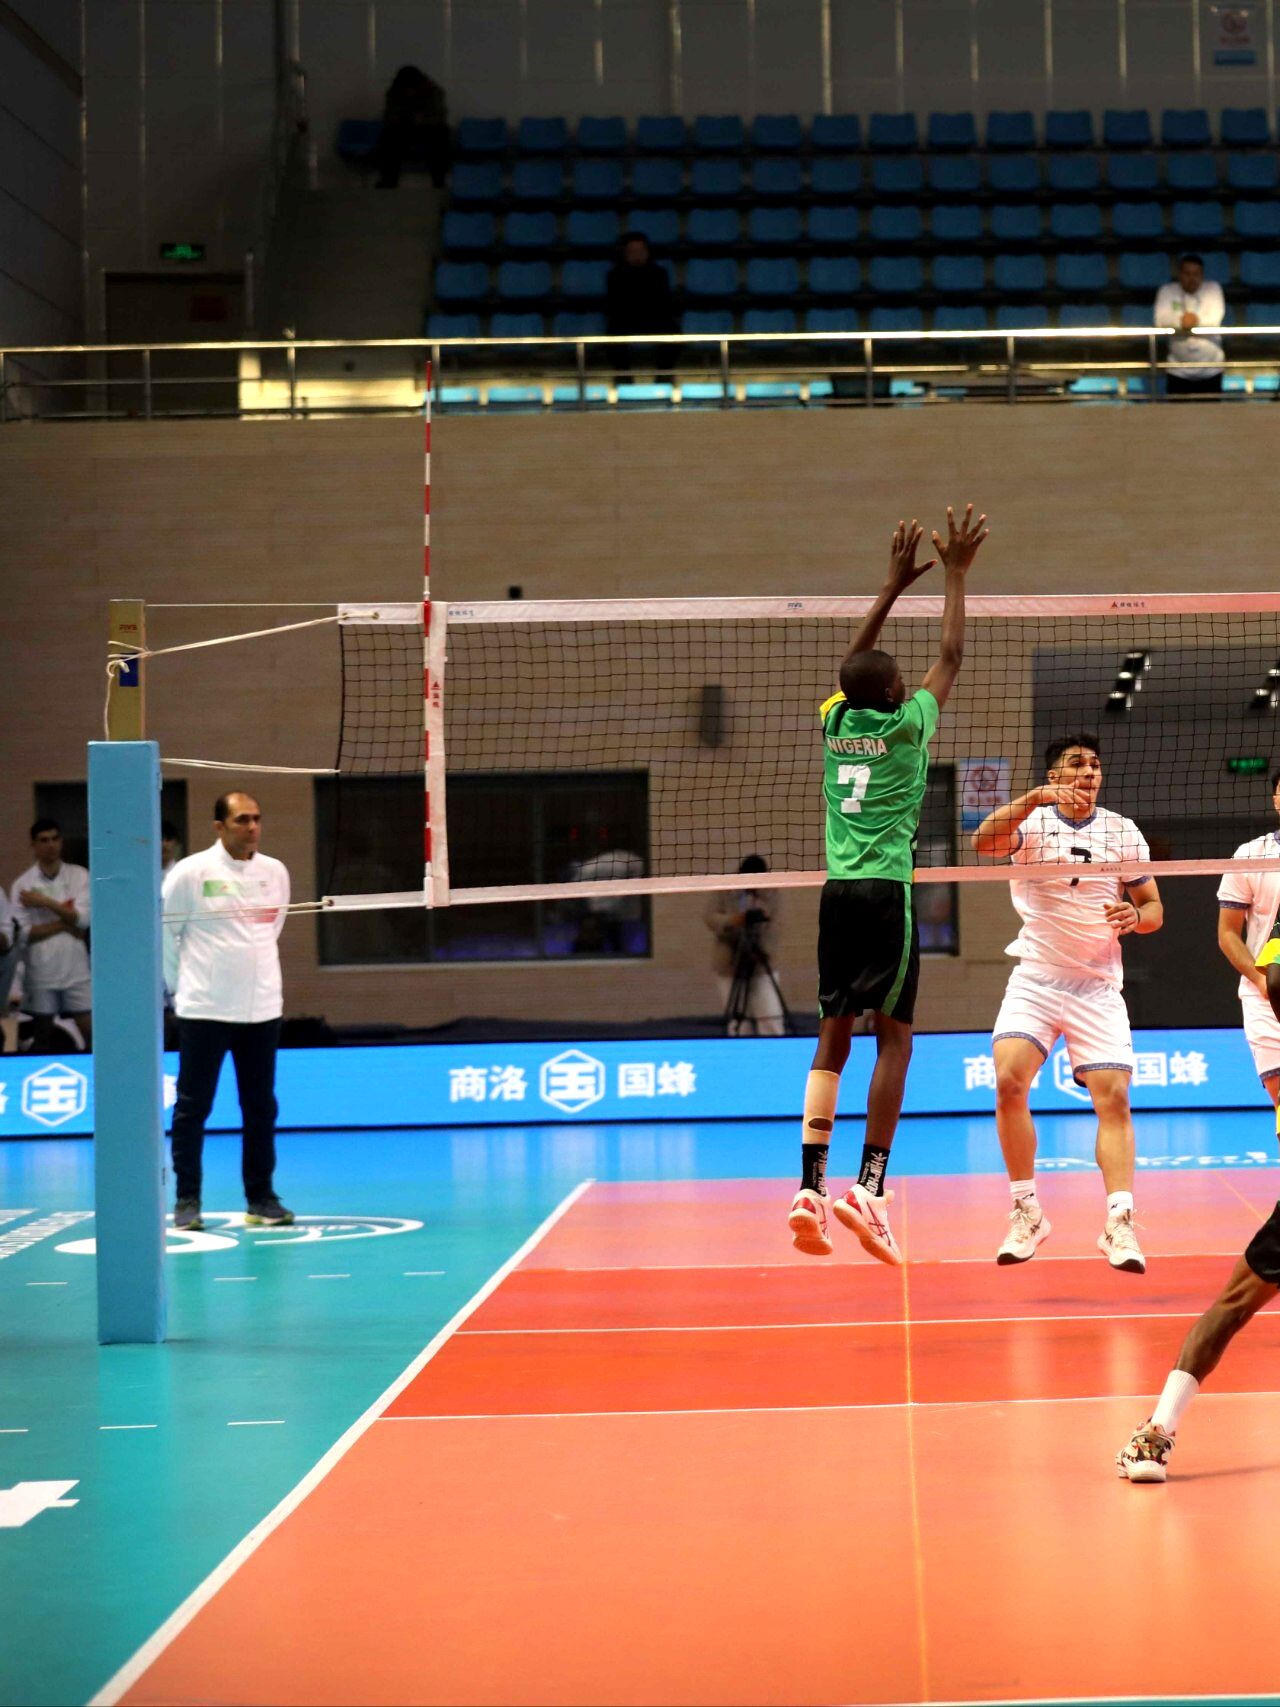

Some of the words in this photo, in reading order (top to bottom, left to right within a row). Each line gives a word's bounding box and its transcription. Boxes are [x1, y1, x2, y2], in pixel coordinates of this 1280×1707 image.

[827, 737, 888, 756] NIGERIA
[837, 764, 872, 813] 7
[449, 1065, 528, 1103] 商洛
[618, 1061, 697, 1098] 国蜂
[1130, 1051, 1210, 1087] 国蜂
